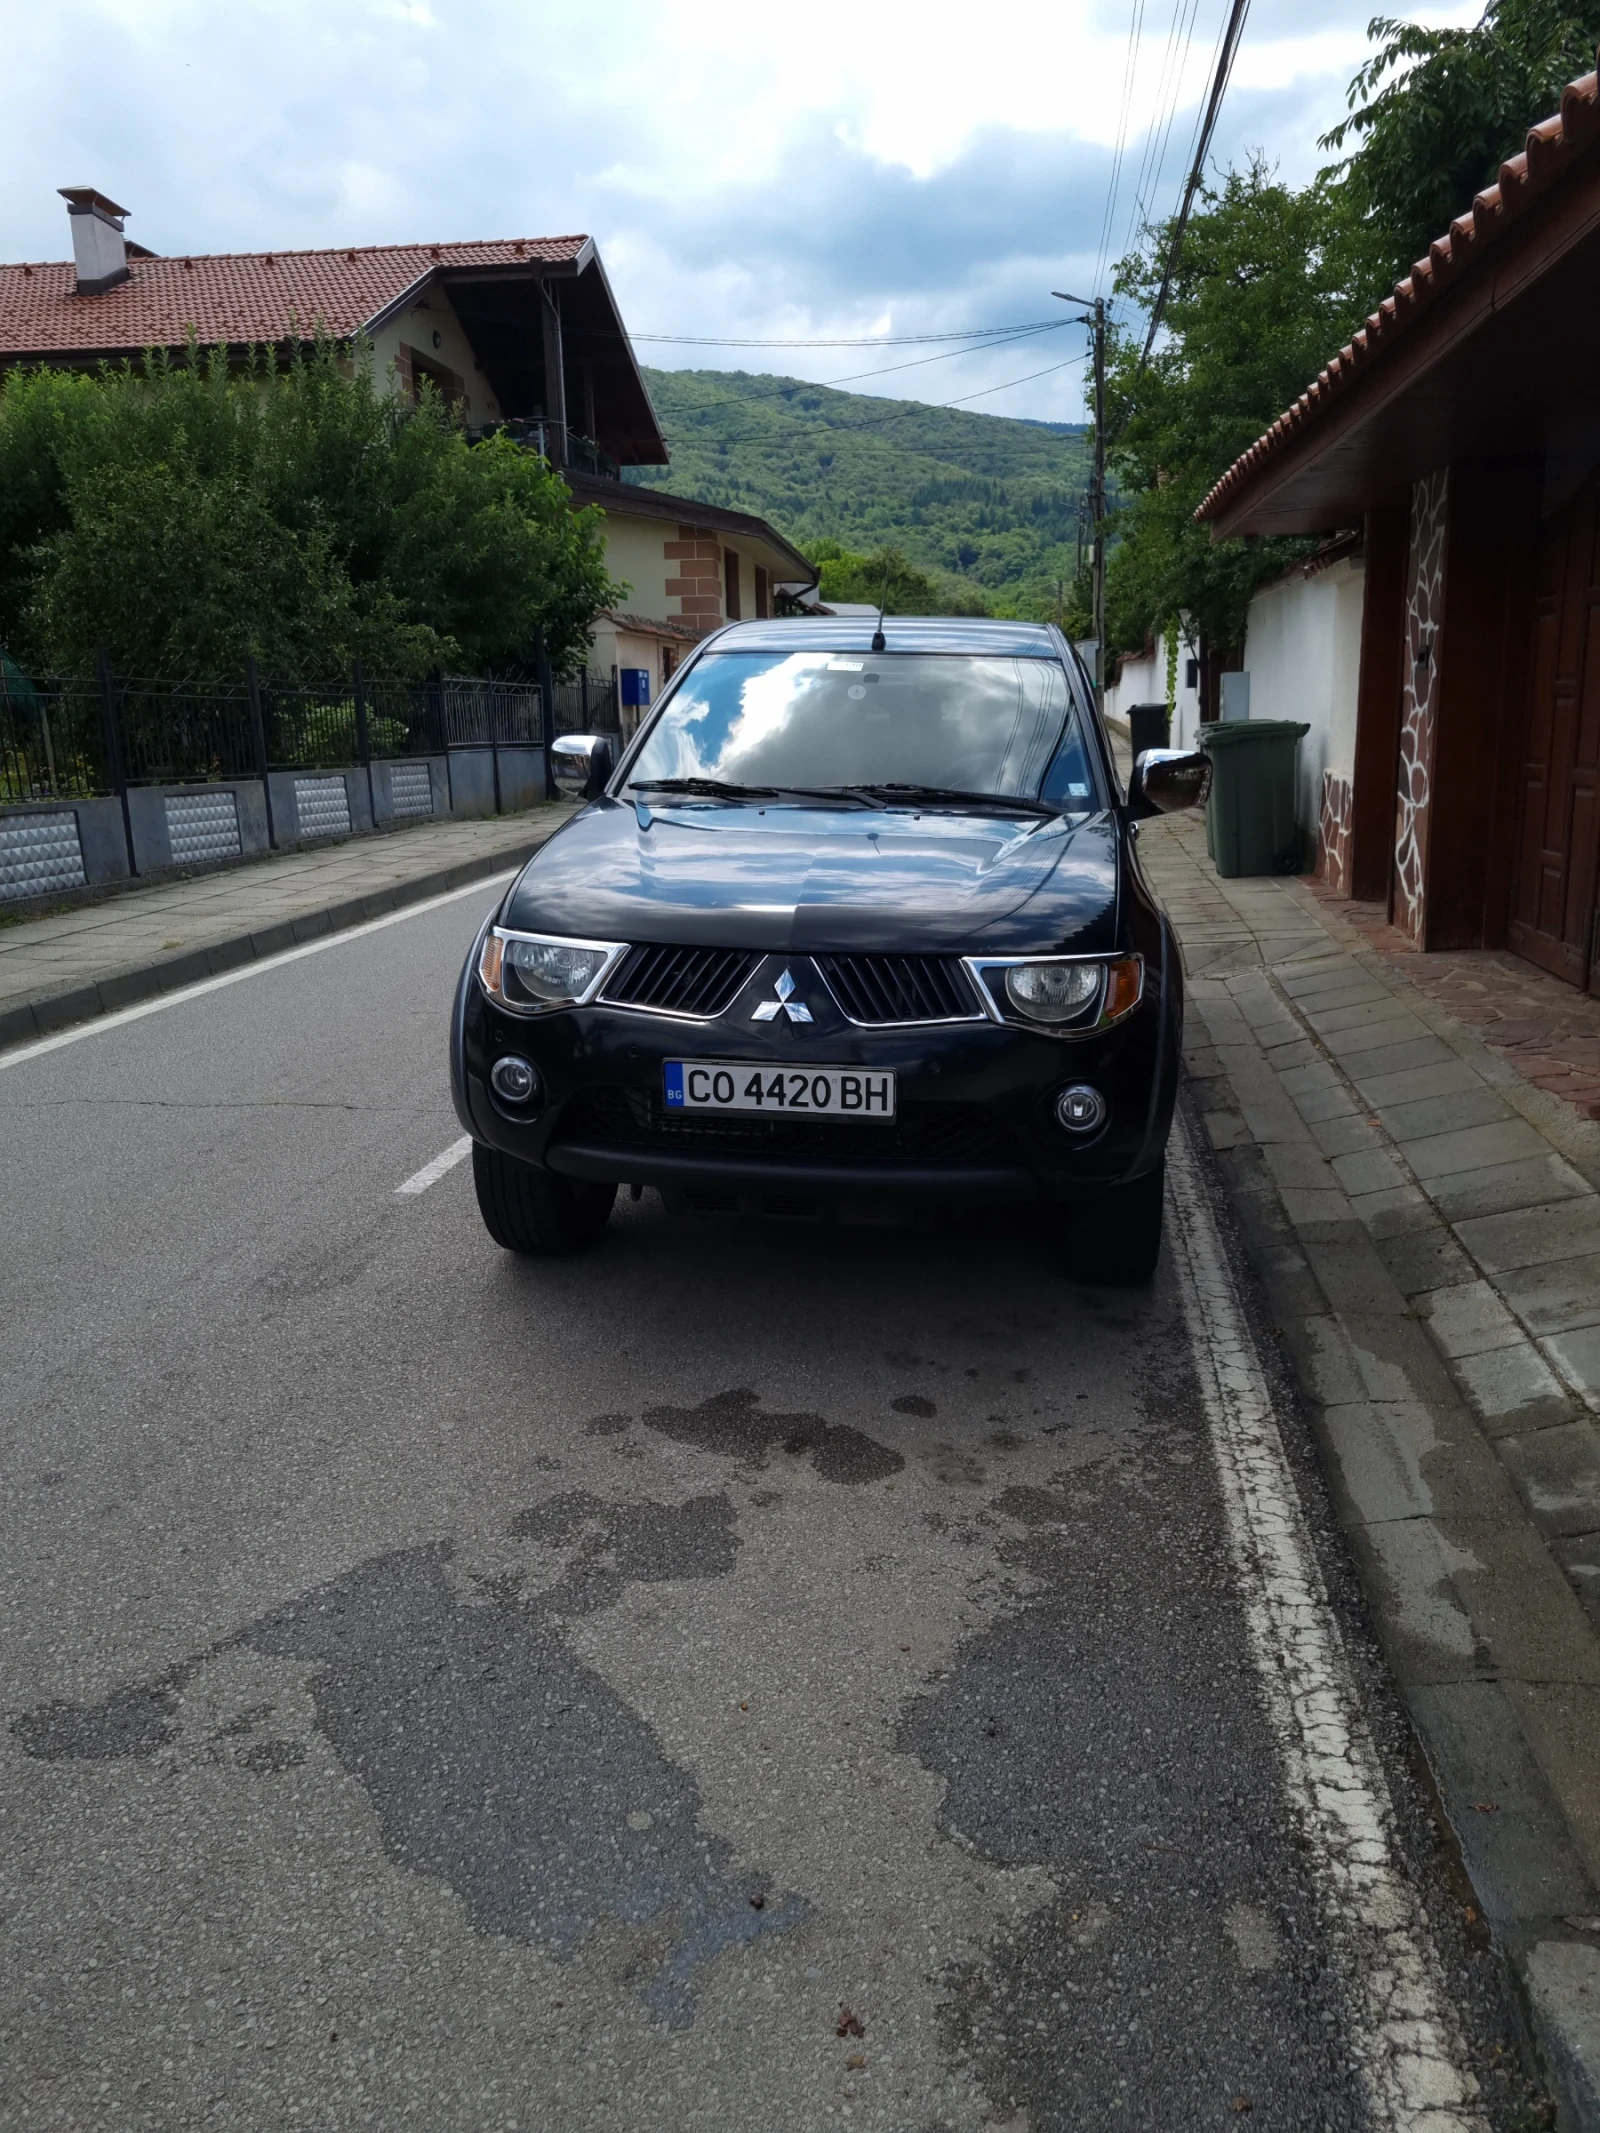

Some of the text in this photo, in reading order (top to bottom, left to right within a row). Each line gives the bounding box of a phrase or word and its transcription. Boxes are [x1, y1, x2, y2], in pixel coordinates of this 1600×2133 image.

[667, 1089, 682, 1099] BG
[688, 1069, 888, 1111] CO 4420 BH
